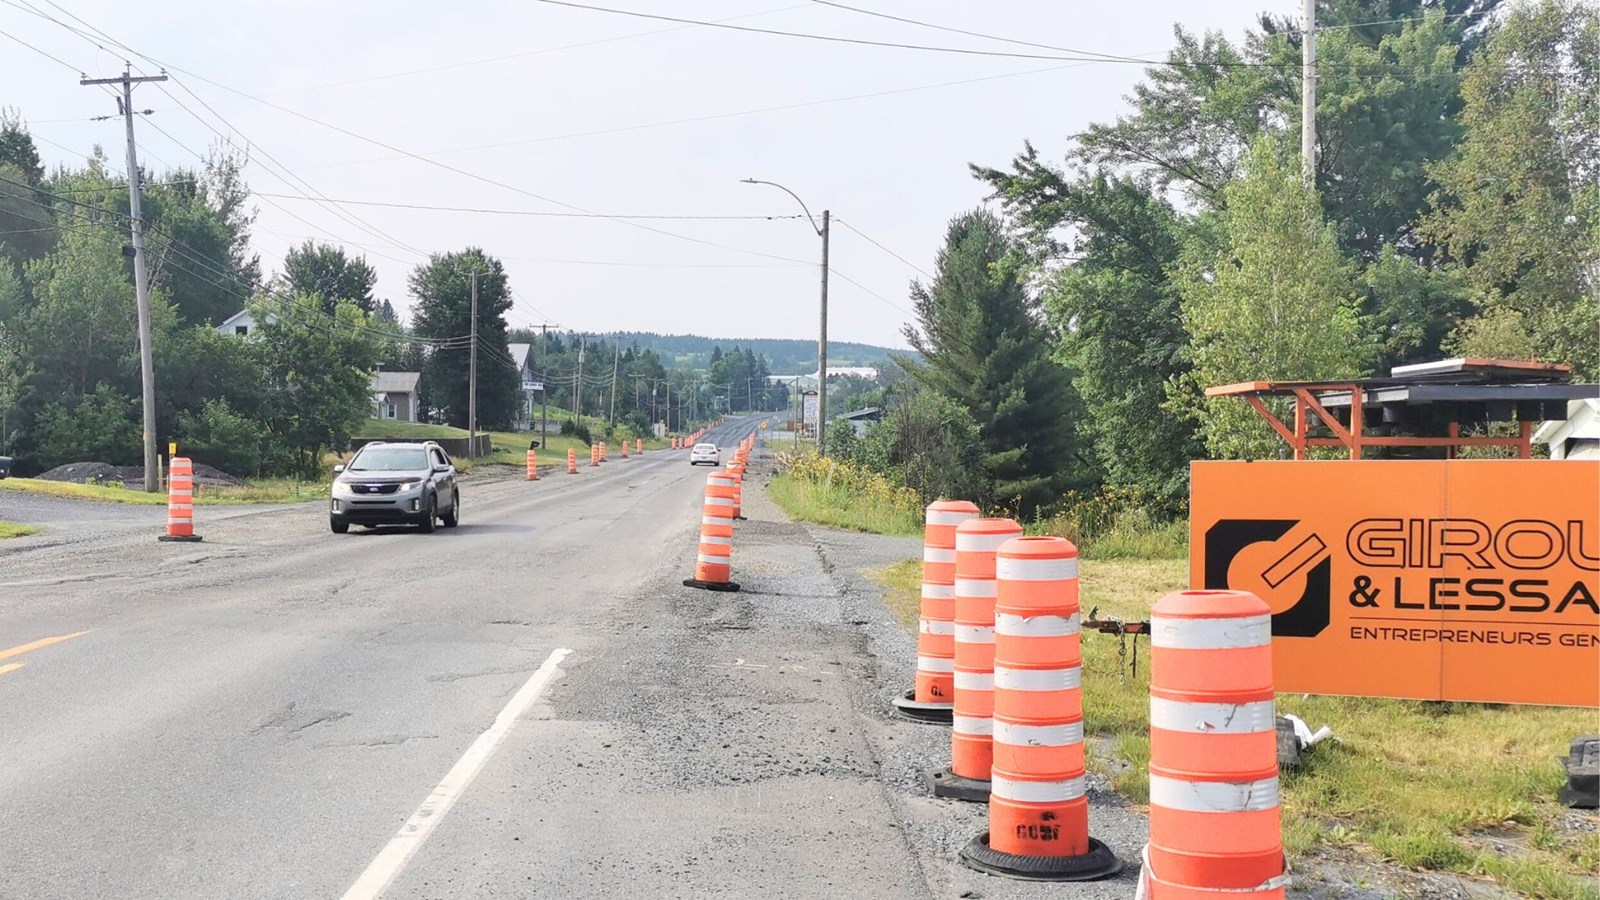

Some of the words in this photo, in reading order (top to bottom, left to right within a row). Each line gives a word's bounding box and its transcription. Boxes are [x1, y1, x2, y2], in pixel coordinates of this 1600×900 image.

[1349, 575, 1381, 608] &
[1394, 577, 1599, 614] LESSA
[1350, 626, 1551, 646] ENTREPRENEURS
